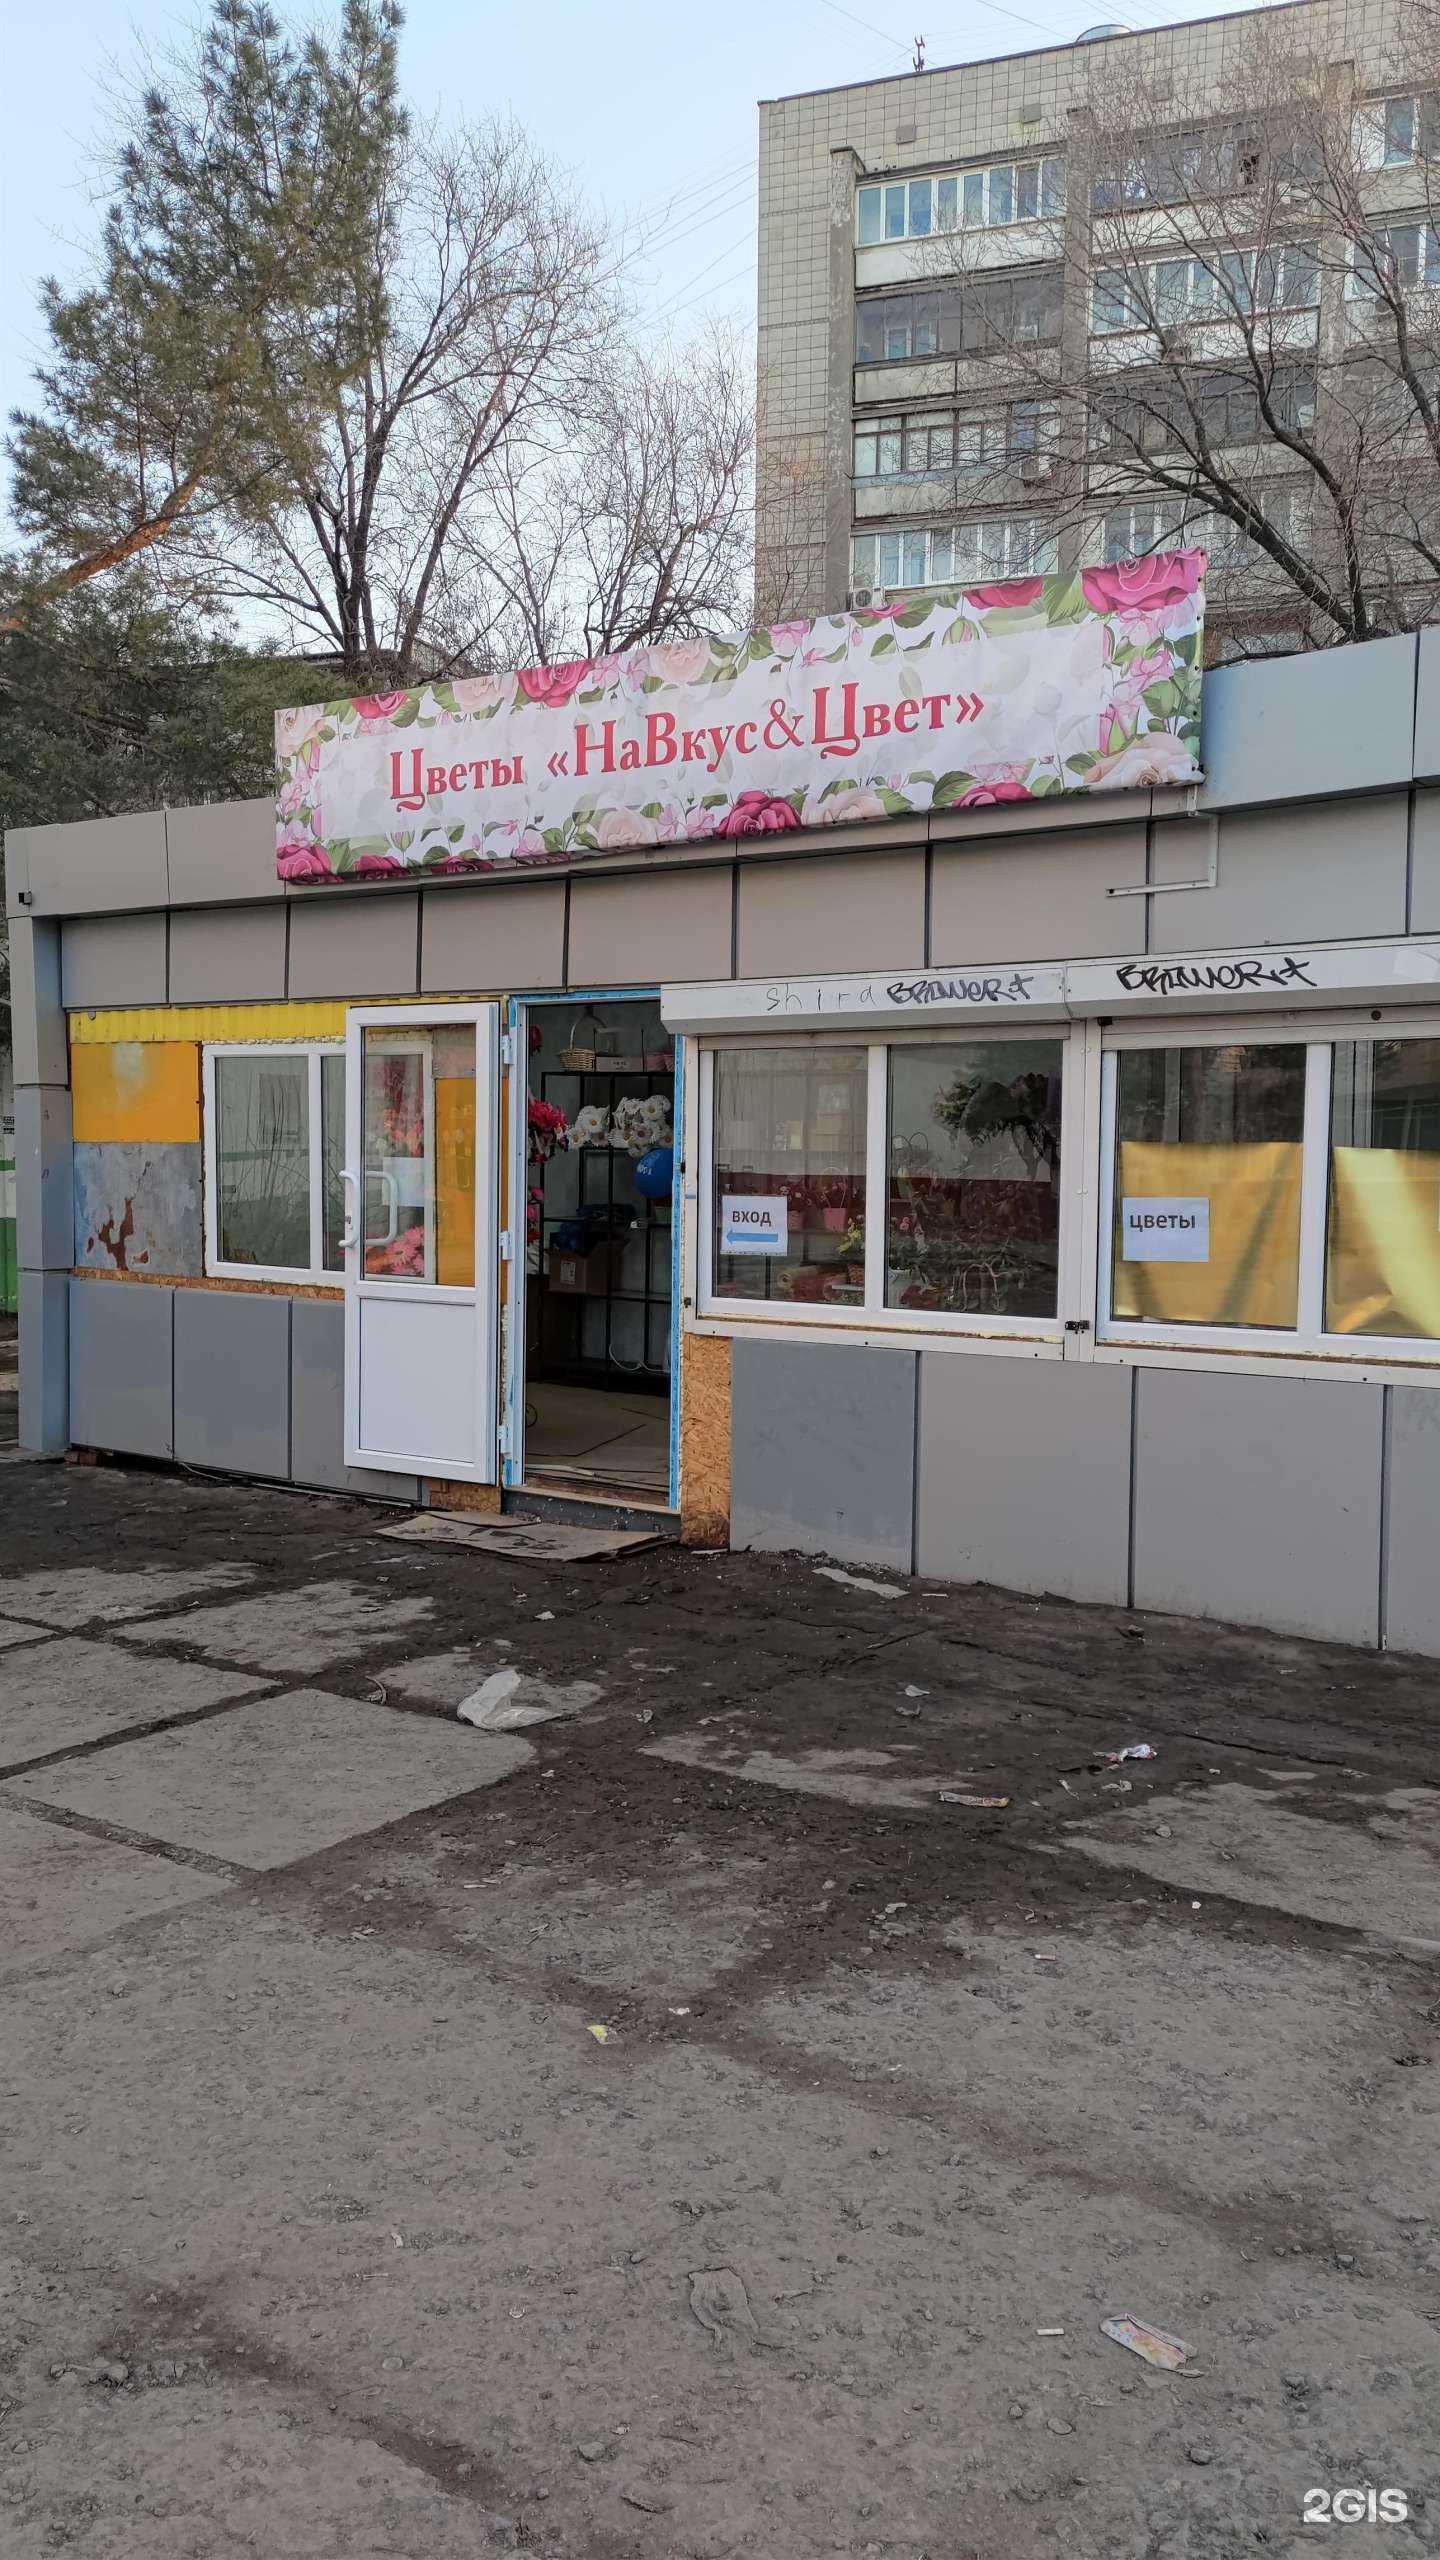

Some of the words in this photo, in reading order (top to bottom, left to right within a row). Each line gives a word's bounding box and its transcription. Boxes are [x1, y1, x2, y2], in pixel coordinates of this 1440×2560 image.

[389, 747, 524, 813] Цветы
[546, 681, 985, 778] «НаВкус&Цвет»
[732, 1210, 772, 1228] вход
[1129, 1214, 1196, 1232] цветы
